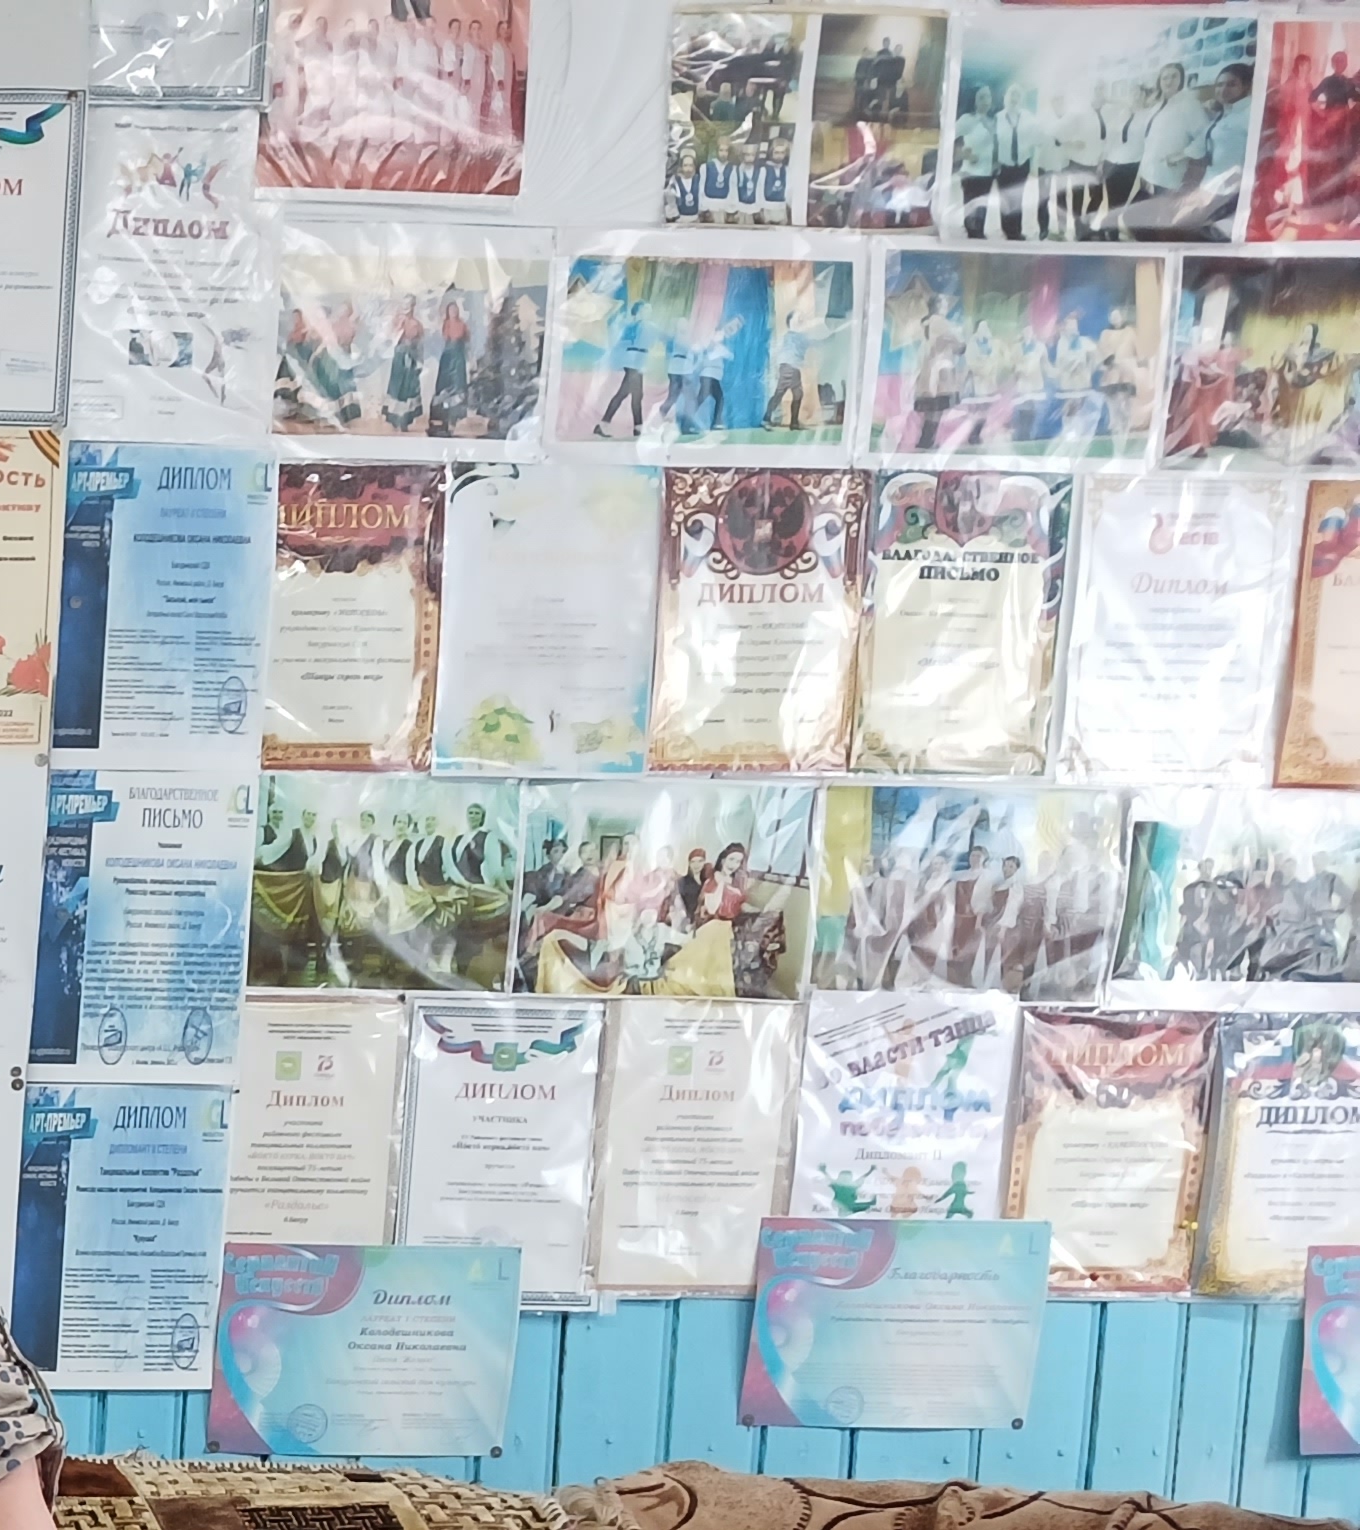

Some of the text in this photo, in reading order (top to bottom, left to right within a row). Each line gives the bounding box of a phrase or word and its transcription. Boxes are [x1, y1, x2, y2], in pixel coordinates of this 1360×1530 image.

[107, 209, 230, 240] Диплом
[157, 466, 231, 491] ДИПЛОМ
[919, 566, 1000, 581] ПИСЬМО
[1130, 571, 1230, 596] Диплом
[697, 583, 824, 606] ДИПЛОМ
[129, 787, 220, 802] БЛАГОДАРСТВЕННОЕ
[141, 807, 203, 828] ПИСЬМО
[266, 1090, 345, 1108] Диплом
[455, 1082, 556, 1101] ДИПЛОМ
[659, 1085, 735, 1103] Диплом
[112, 1105, 187, 1131] ДИПЛОМ
[372, 1289, 452, 1306] Диплом
